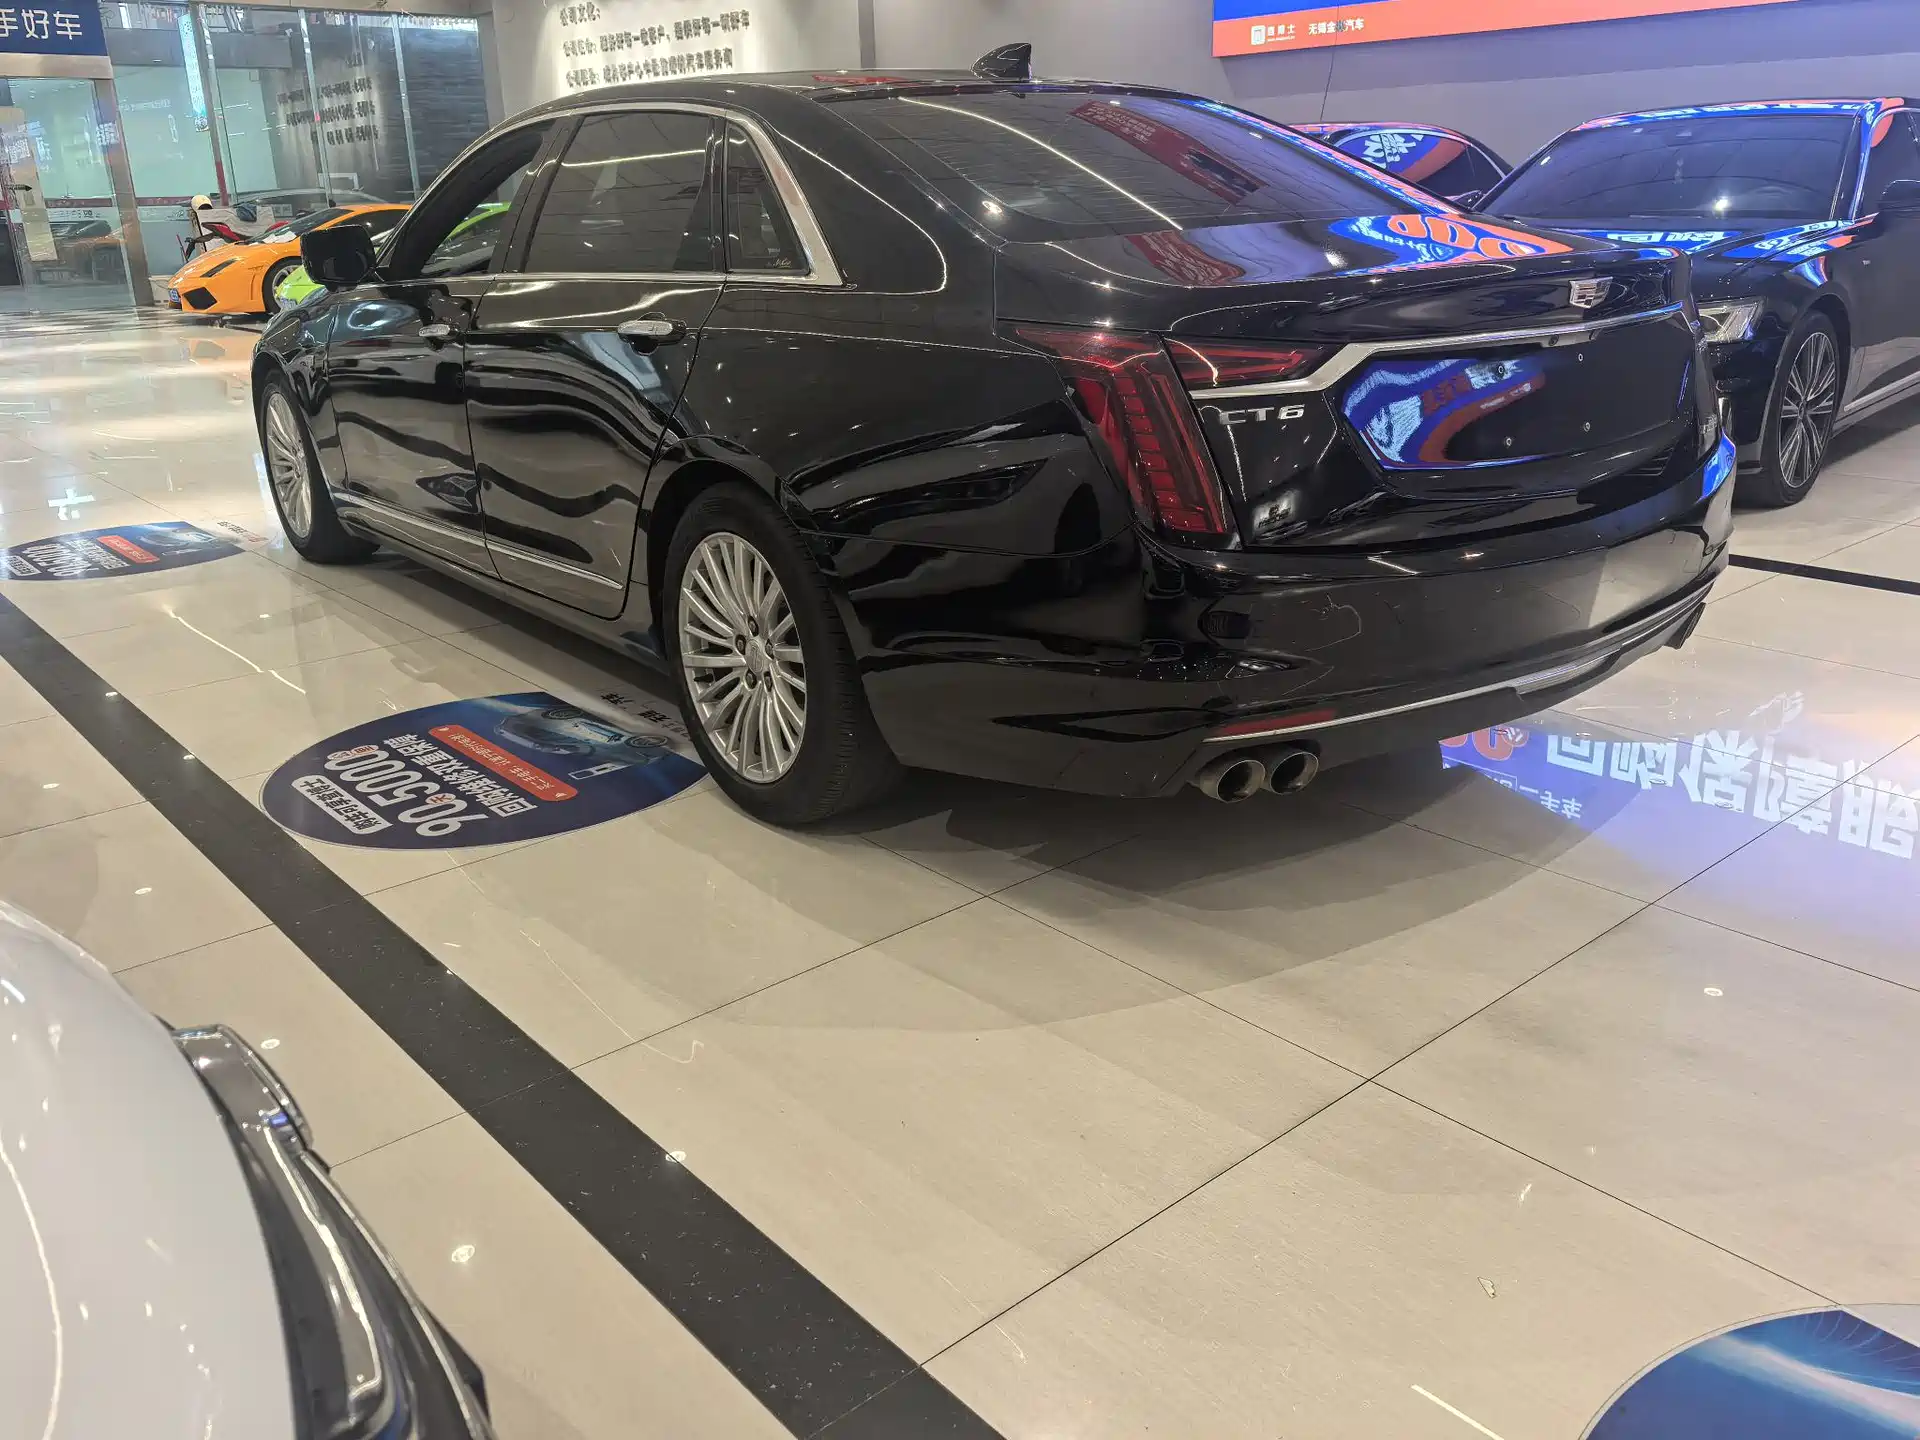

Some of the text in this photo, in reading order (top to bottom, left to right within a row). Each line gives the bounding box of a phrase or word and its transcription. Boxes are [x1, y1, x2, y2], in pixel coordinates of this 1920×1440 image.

[1219, 404, 1305, 425] CT6
[383, 733, 539, 817] 回购维修双重保障
